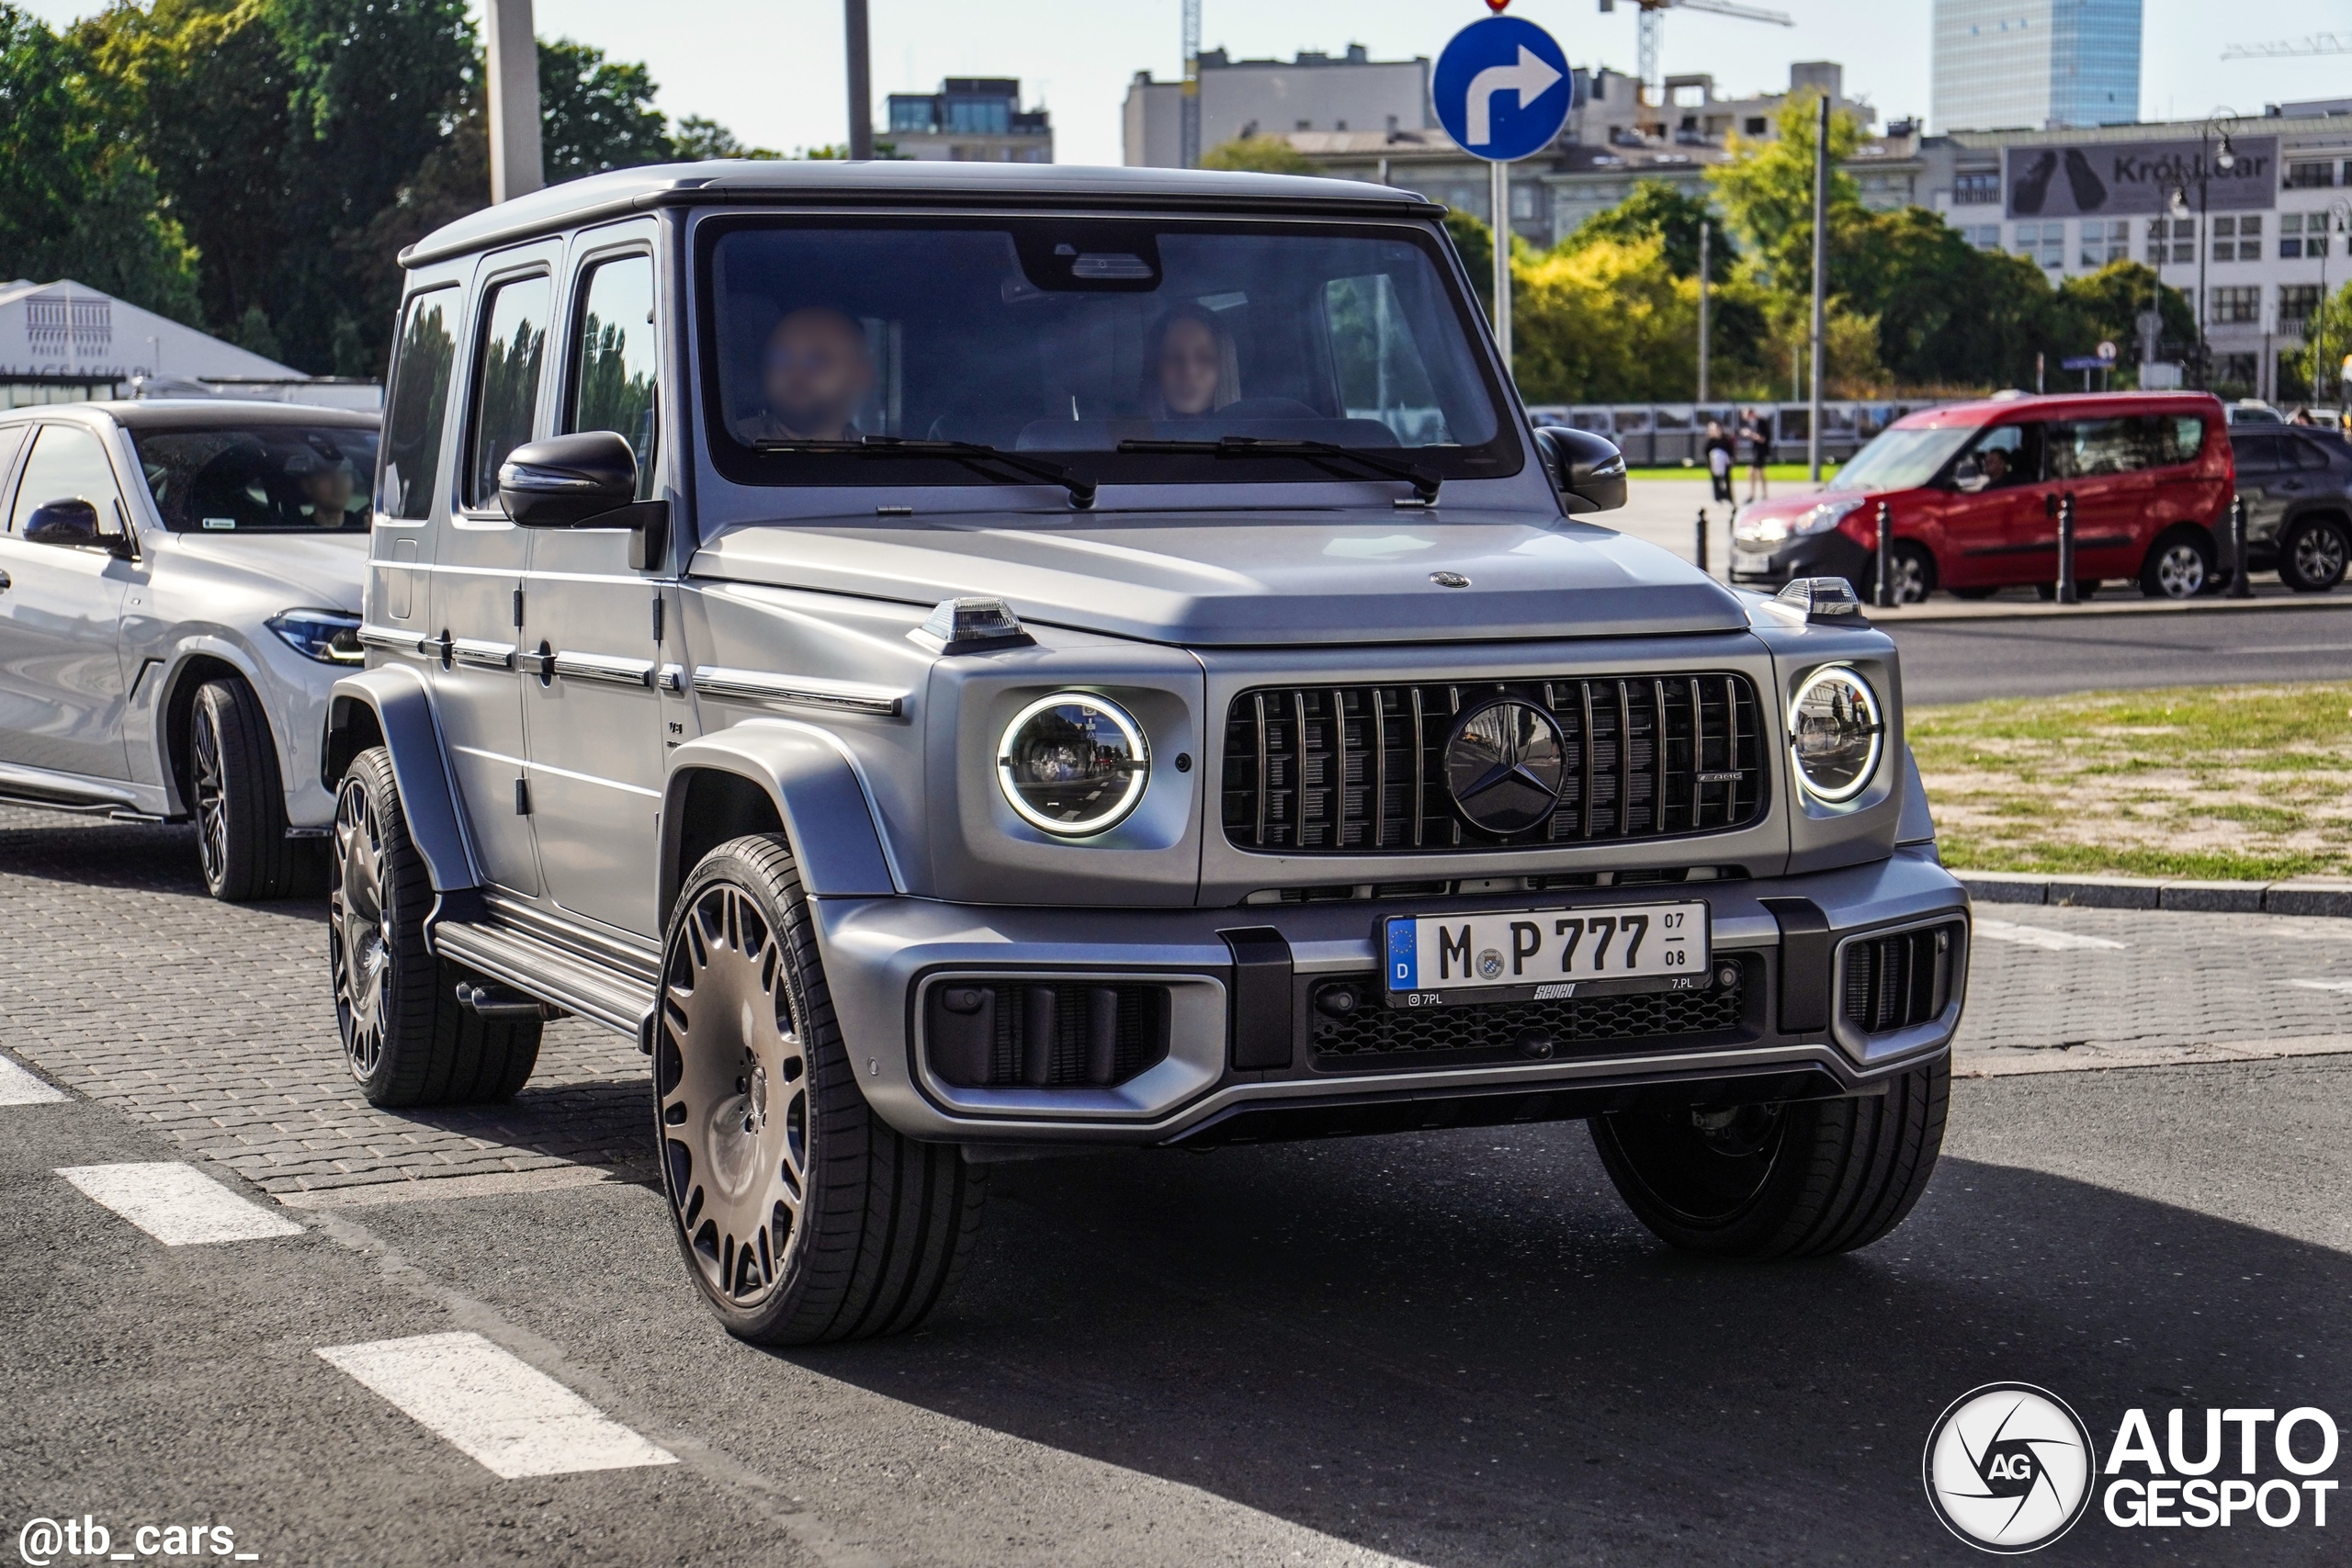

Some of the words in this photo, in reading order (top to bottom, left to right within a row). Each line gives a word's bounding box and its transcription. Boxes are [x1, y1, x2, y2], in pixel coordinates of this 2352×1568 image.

[1664, 912, 1685, 929] 07
[1440, 923, 1473, 979] M
[1665, 950, 1686, 966] 08
[1396, 963, 1409, 979] D
[1671, 977, 1694, 990] 7.PL
[1422, 993, 1442, 1005] 7PL
